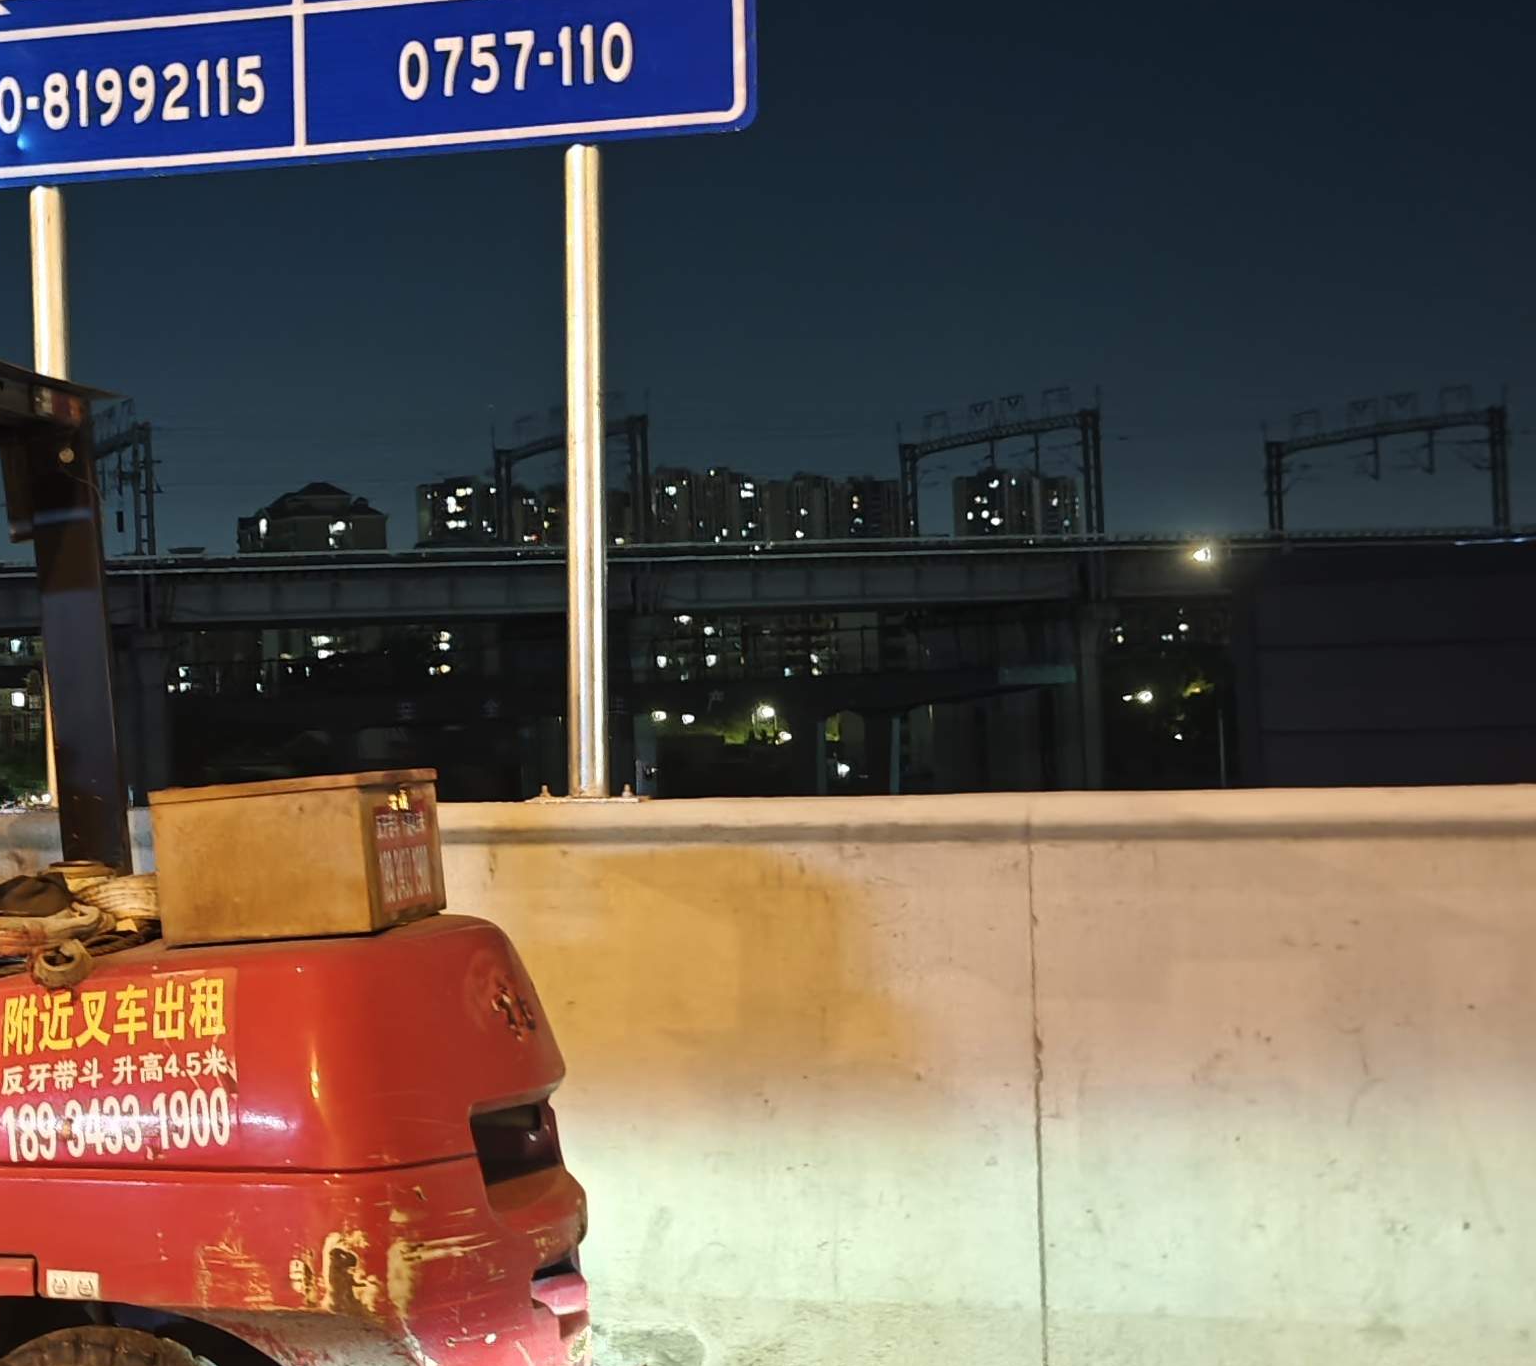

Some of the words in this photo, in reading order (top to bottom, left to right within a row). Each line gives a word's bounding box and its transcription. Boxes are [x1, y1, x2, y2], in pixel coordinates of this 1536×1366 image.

[398, 22, 634, 102] 0757-110
[2, 976, 227, 1058] 附近叉车出租
[111, 1044, 229, 1086] 升高4.5米
